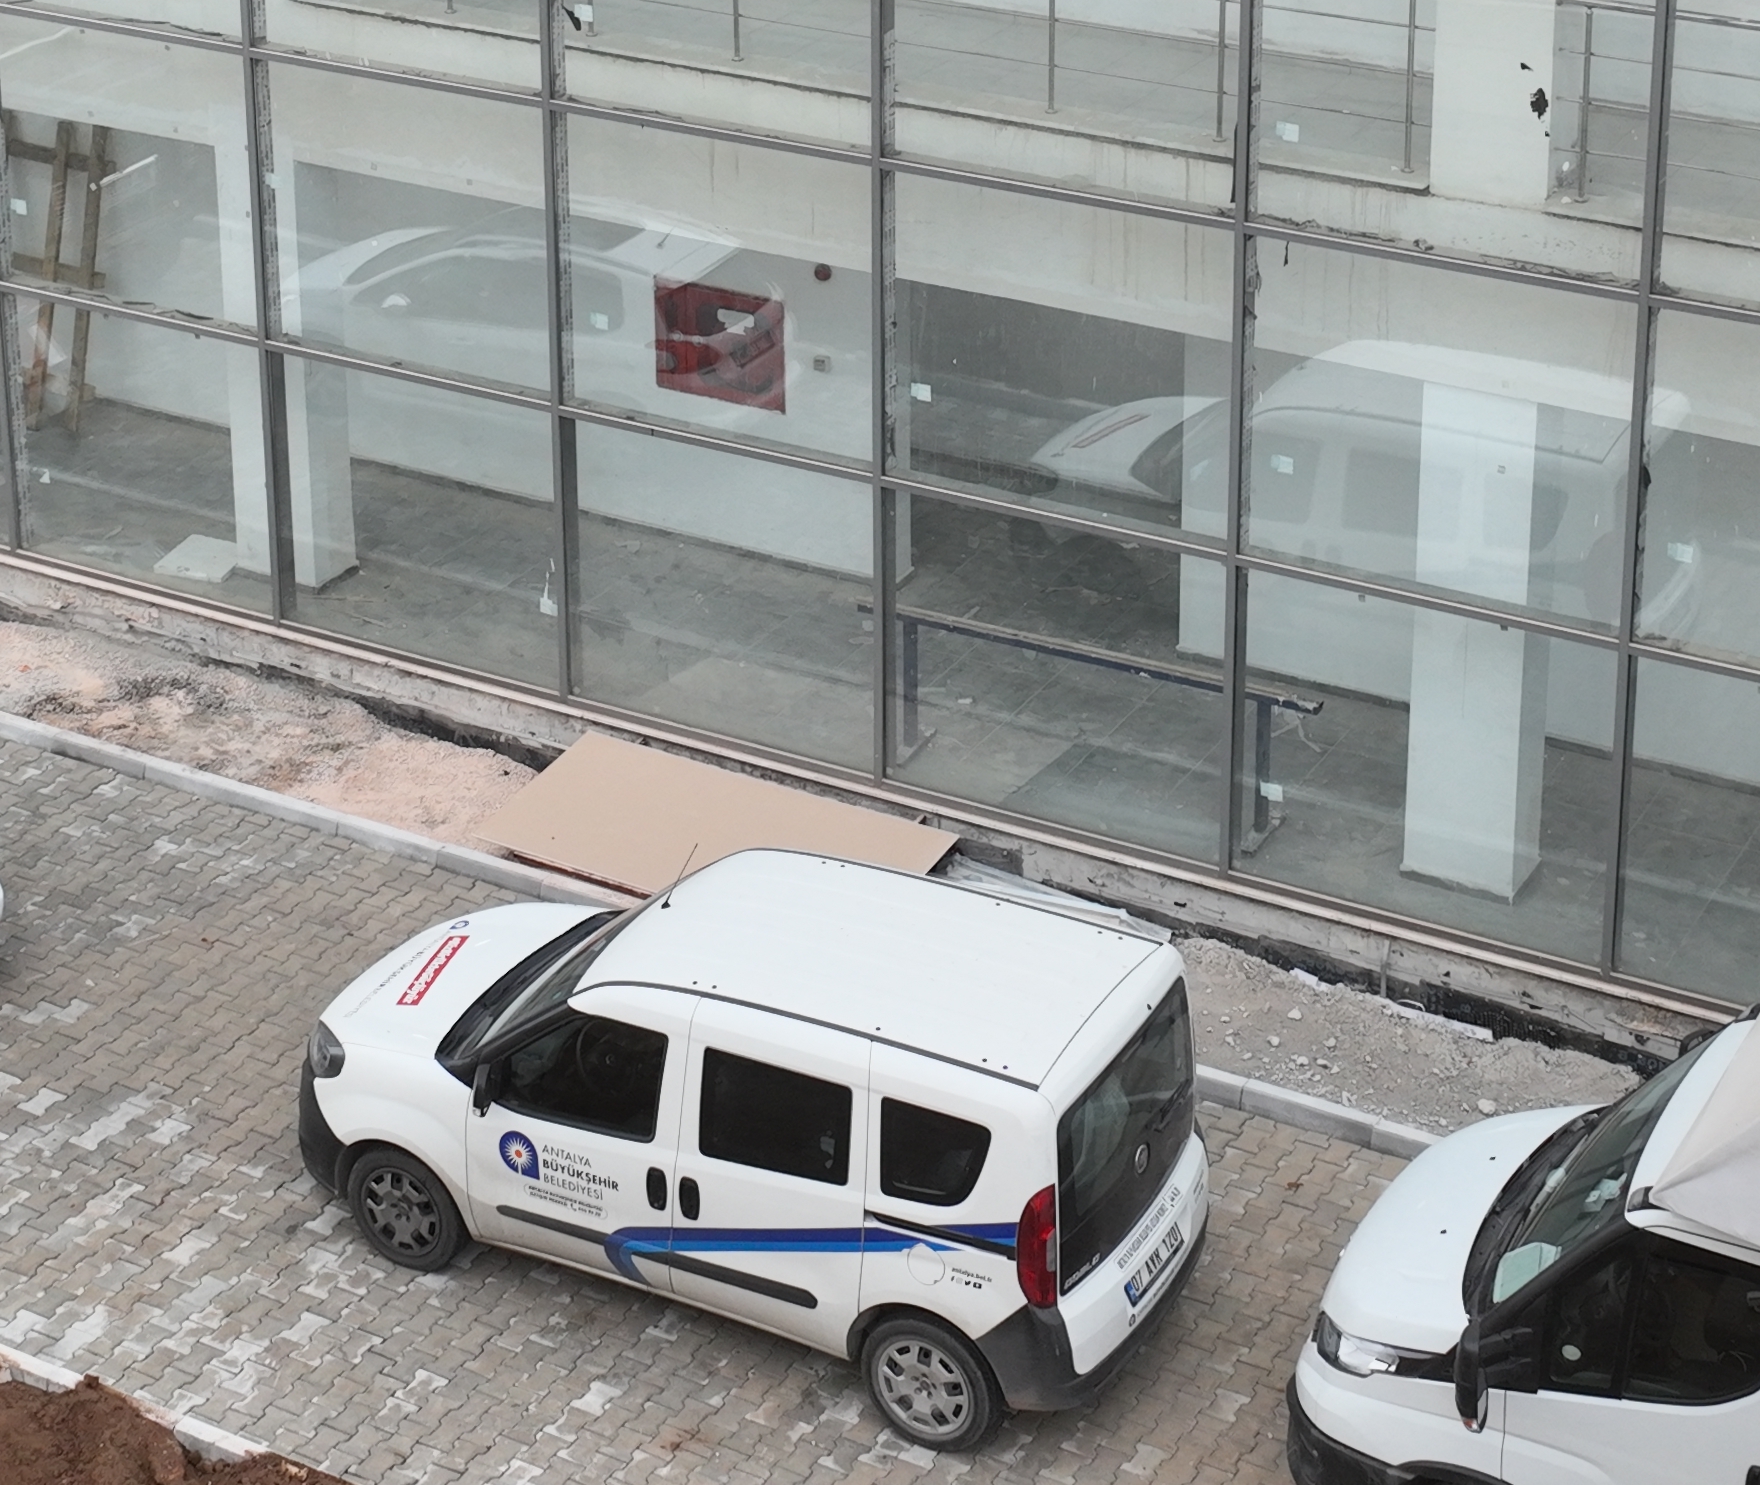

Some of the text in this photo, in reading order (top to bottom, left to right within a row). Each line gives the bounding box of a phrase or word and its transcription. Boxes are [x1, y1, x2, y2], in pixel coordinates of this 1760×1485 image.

[542, 1144, 592, 1169] ANTALYA
[542, 1158, 620, 1192] BÜYÜKŞEHİR
[543, 1172, 604, 1201] BELEDİYESİ
[1130, 1268, 1144, 1293] 07
